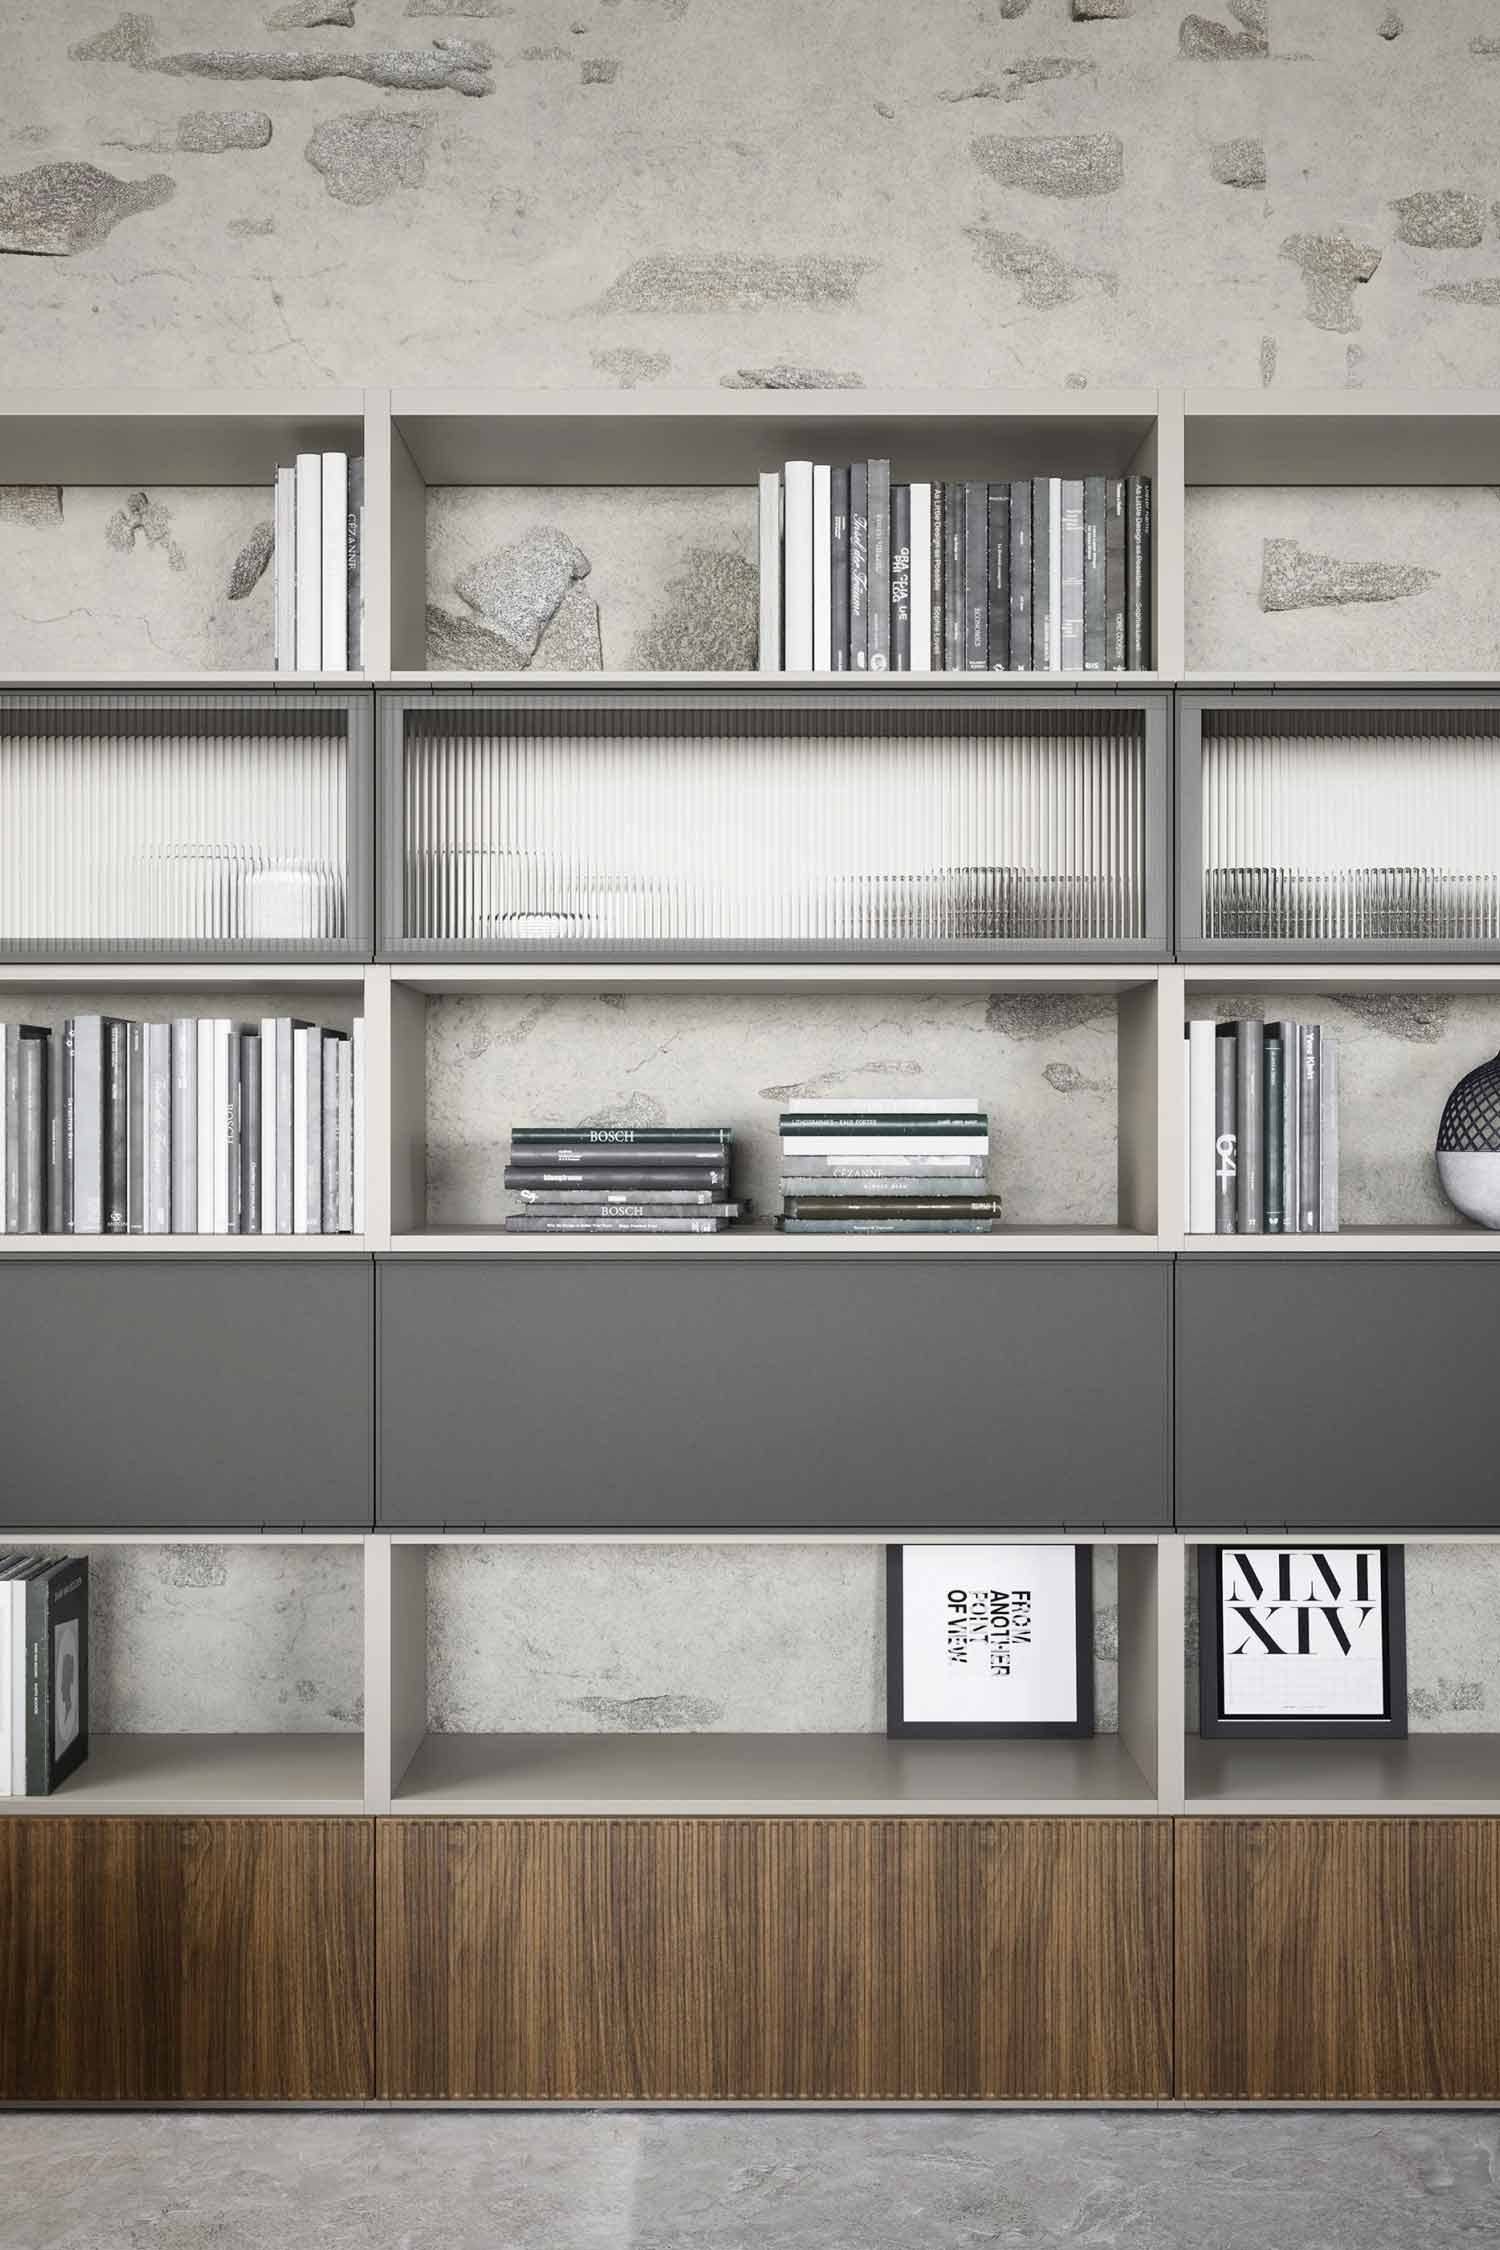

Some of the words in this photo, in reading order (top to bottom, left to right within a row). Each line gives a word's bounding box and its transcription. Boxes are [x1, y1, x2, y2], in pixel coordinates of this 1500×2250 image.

[932, 521, 941, 548] Design
[589, 1130, 635, 1143] BOSCH
[600, 1206, 644, 1217] BOSCH
[947, 1589, 968, 1615] OF
[1011, 1590, 1031, 1645] FROM
[947, 1616, 968, 1664] VIEW
[990, 1589, 1011, 1676] ANOTHER
[1226, 1606, 1377, 1657] XIV
